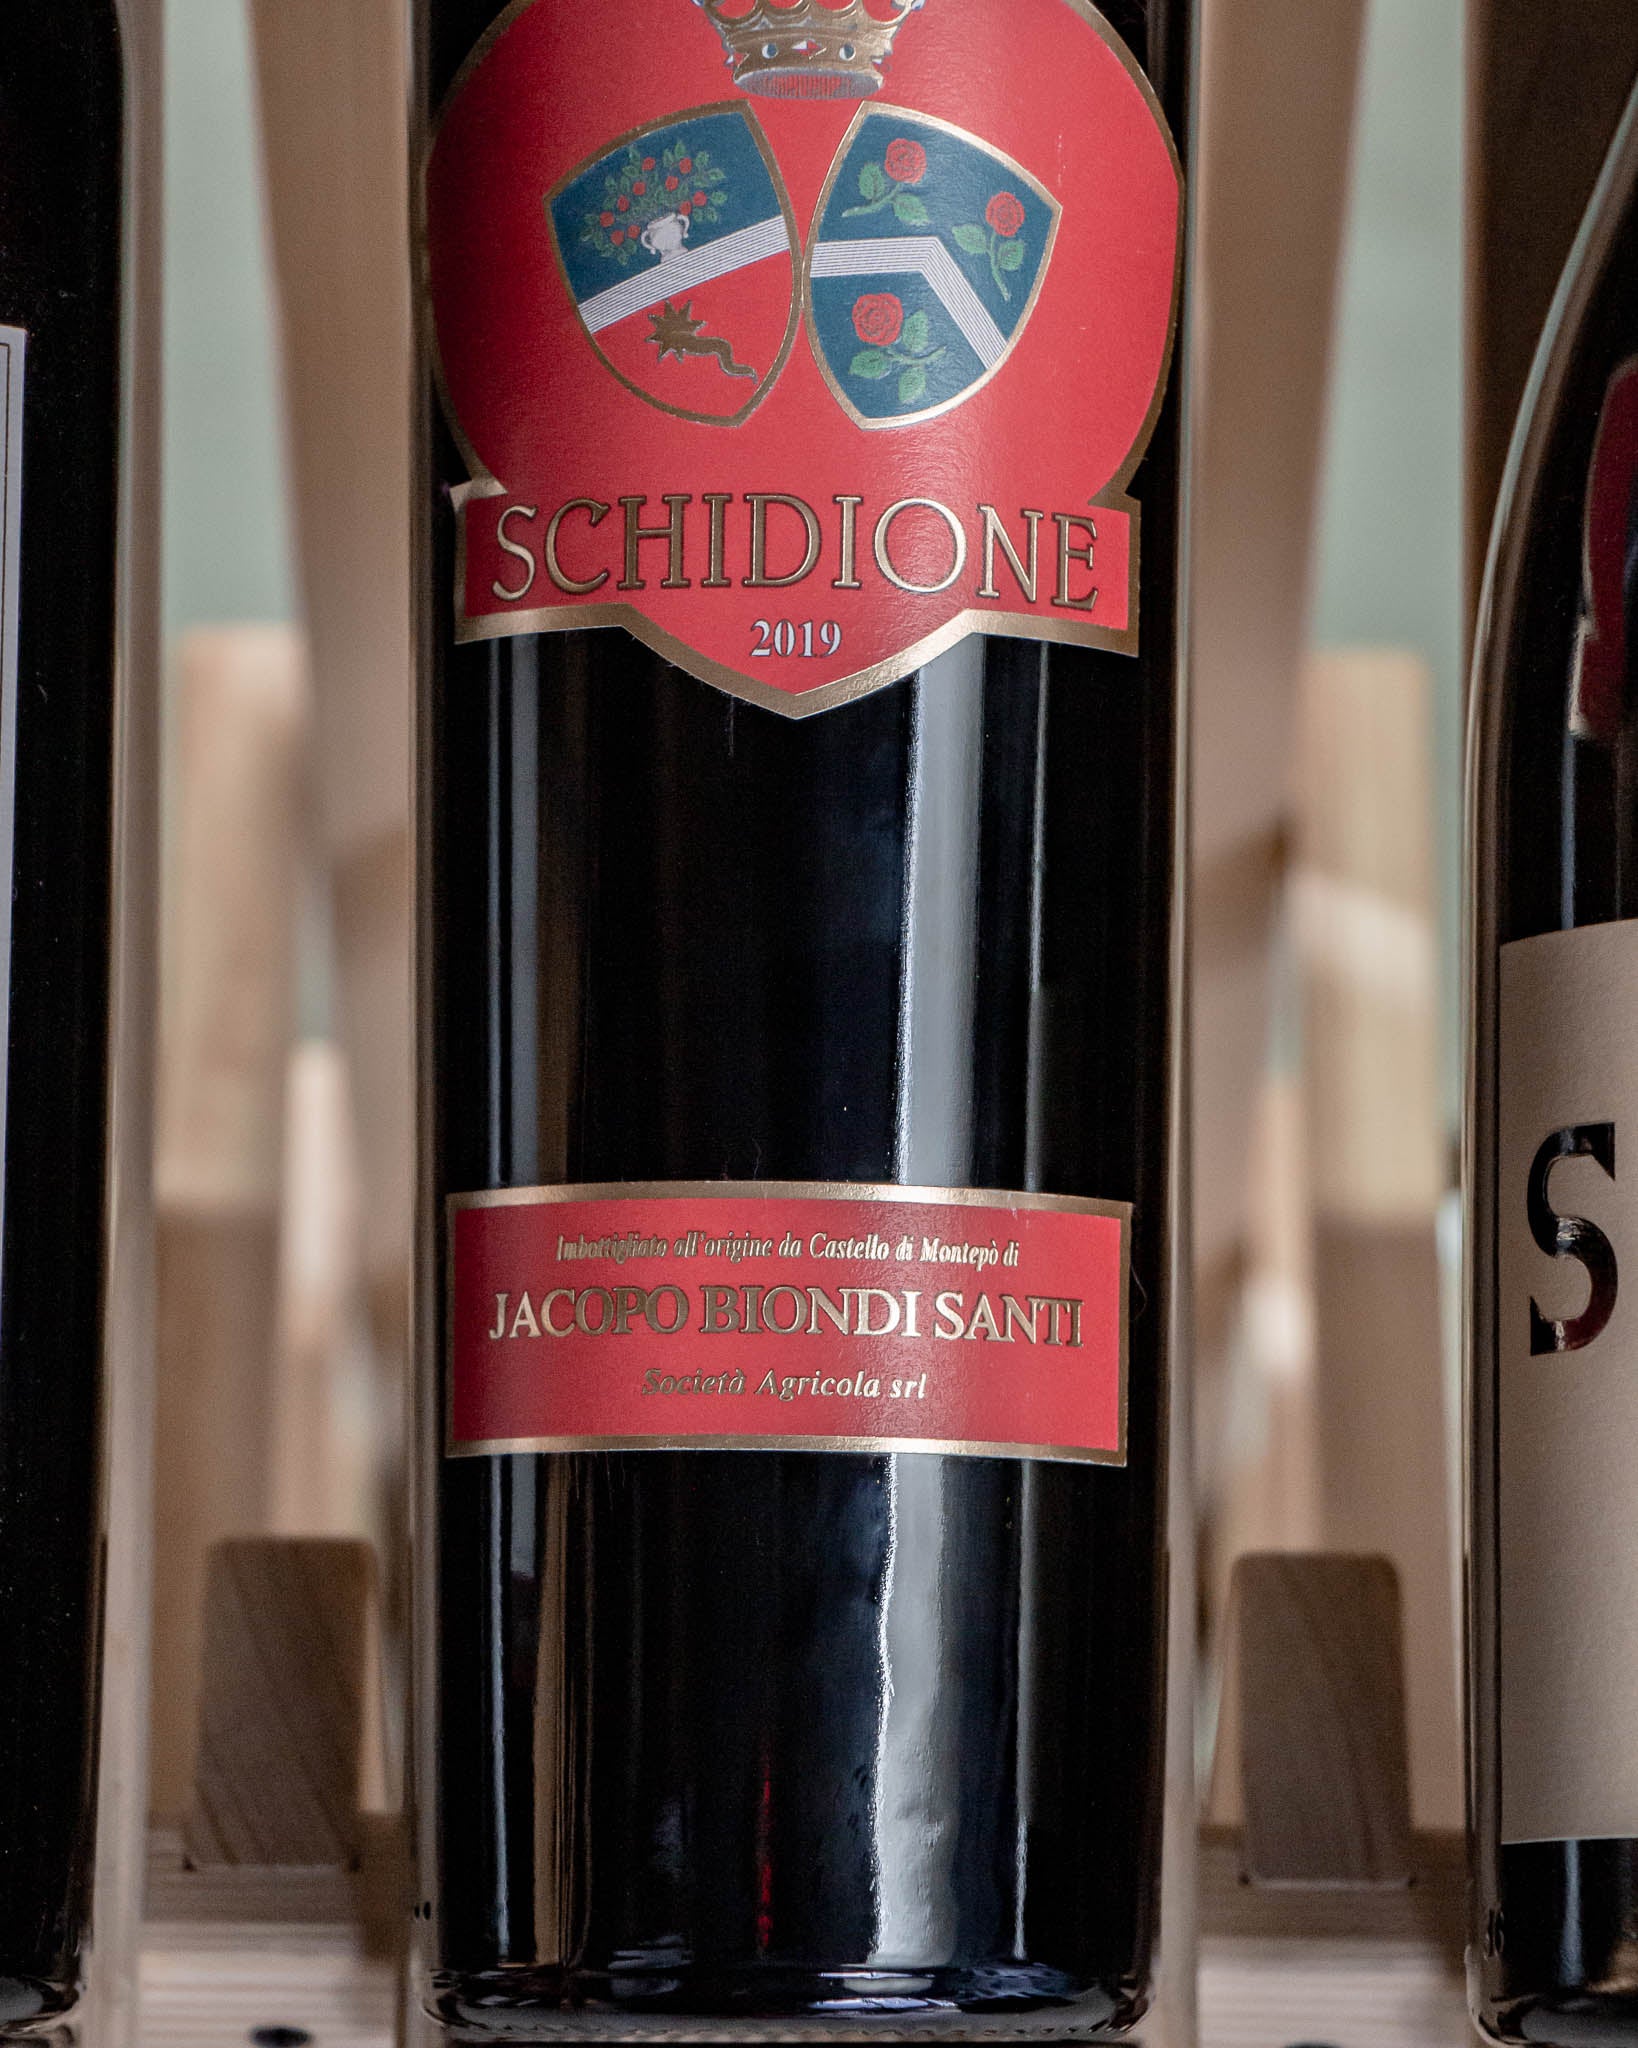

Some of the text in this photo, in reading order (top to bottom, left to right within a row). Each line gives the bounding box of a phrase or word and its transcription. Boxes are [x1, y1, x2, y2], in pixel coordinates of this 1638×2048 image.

[491, 494, 1099, 611] SCHIDIONE
[750, 619, 842, 659] 2019
[555, 1231, 1020, 1271] Imbottigliato all'origine da Castello di Montepò di
[488, 1284, 1084, 1347] JACOPO BIONDI SANTI
[642, 1367, 928, 1401] Società Agricola srl
